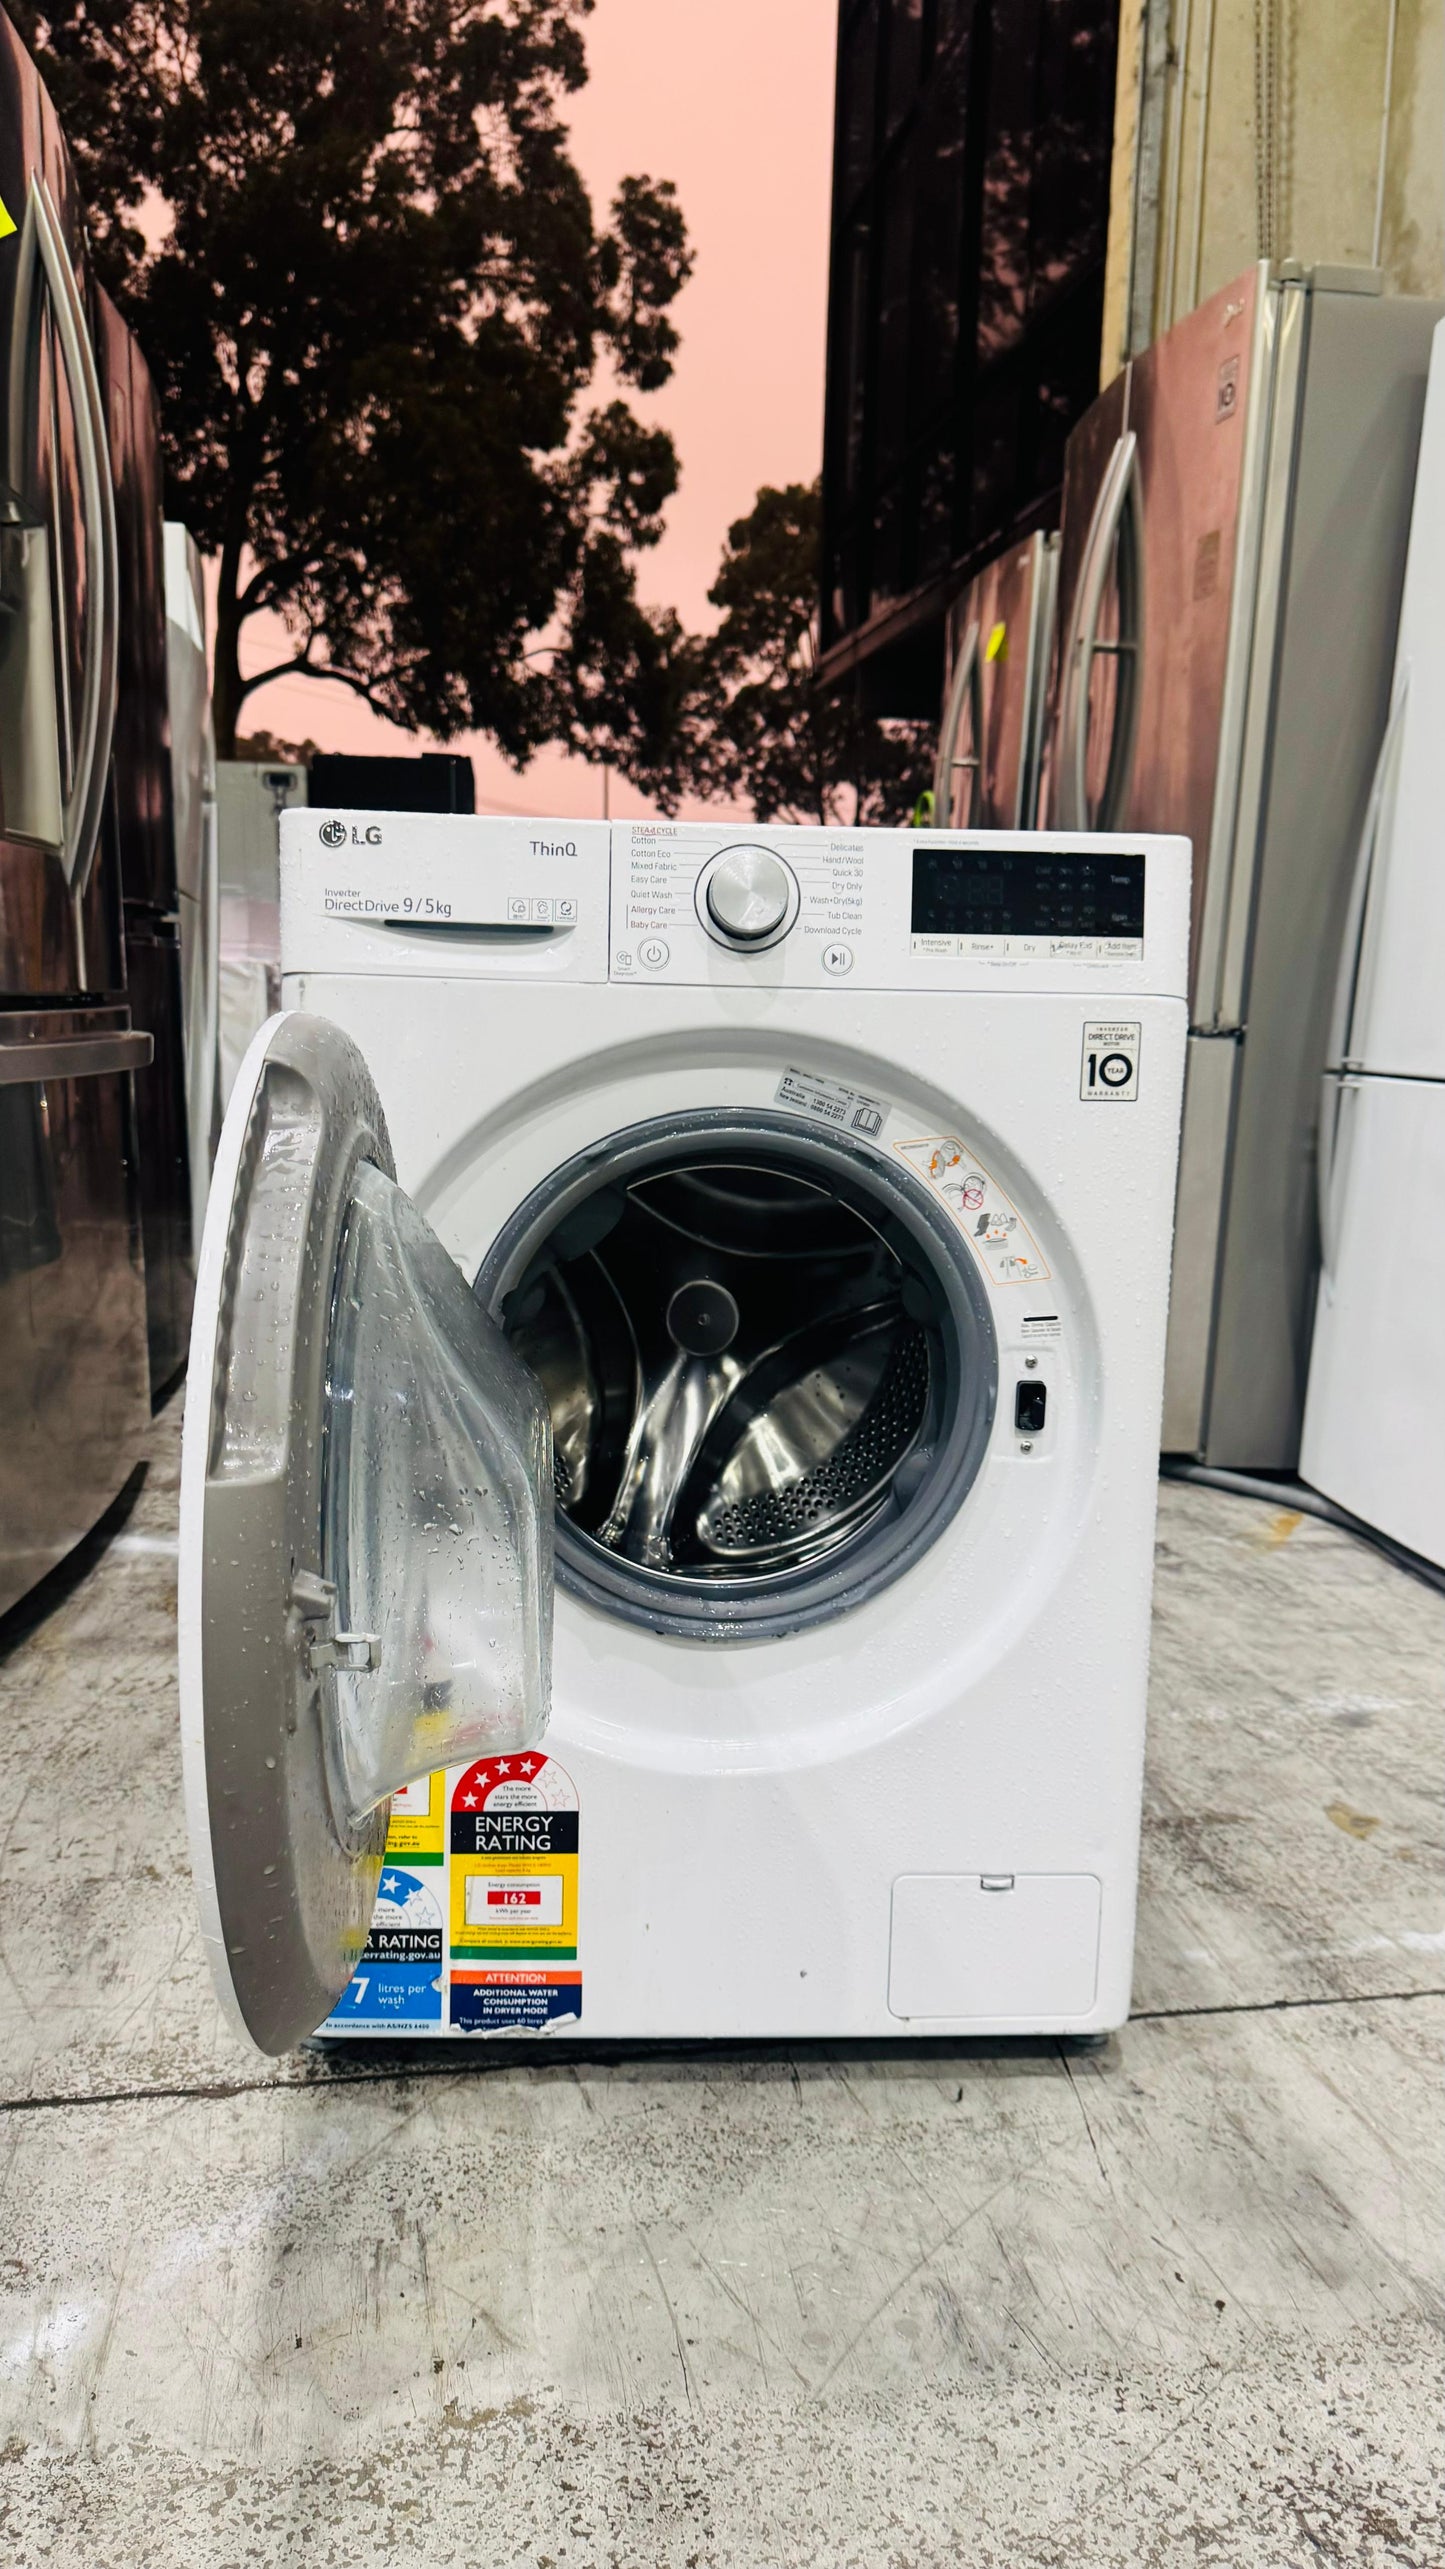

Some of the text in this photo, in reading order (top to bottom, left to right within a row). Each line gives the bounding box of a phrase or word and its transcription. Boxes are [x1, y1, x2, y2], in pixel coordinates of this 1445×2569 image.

[351, 826, 382, 845] LG
[631, 836, 656, 844] Cotton
[529, 841, 578, 856] ThinQ
[831, 843, 864, 851] Delicates
[631, 849, 655, 857] Cotton
[631, 862, 677, 870] Mixed Fabric
[833, 869, 863, 877] Quick 30
[631, 875, 667, 884] Easy Care
[832, 882, 862, 891] Dry Only
[325, 888, 361, 897] Inverter
[631, 890, 672, 899] Quiet Wash
[631, 905, 676, 915] Allergy Care
[631, 921, 667, 929] Baby Care
[804, 926, 862, 935] Download Cycle
[921, 939, 951, 947] Intensive
[1024, 944, 1036, 952] Dry
[1088, 1053, 1133, 1087] 10
[781, 1086, 806, 1099] Australia
[475, 1816, 553, 1832] ENERGY
[475, 1835, 552, 1851] RATING
[504, 1893, 526, 1904] 162
[379, 1935, 440, 1948] RATING
[362, 1950, 440, 1961] errating.gov.au
[485, 1973, 547, 1983] ATTENTION
[351, 1977, 370, 2004] 7
[378, 1983, 426, 1995] litres per
[378, 1995, 405, 2005] wash
[483, 1998, 548, 2006] CONSUMPTION
[474, 2017, 500, 2025] product
